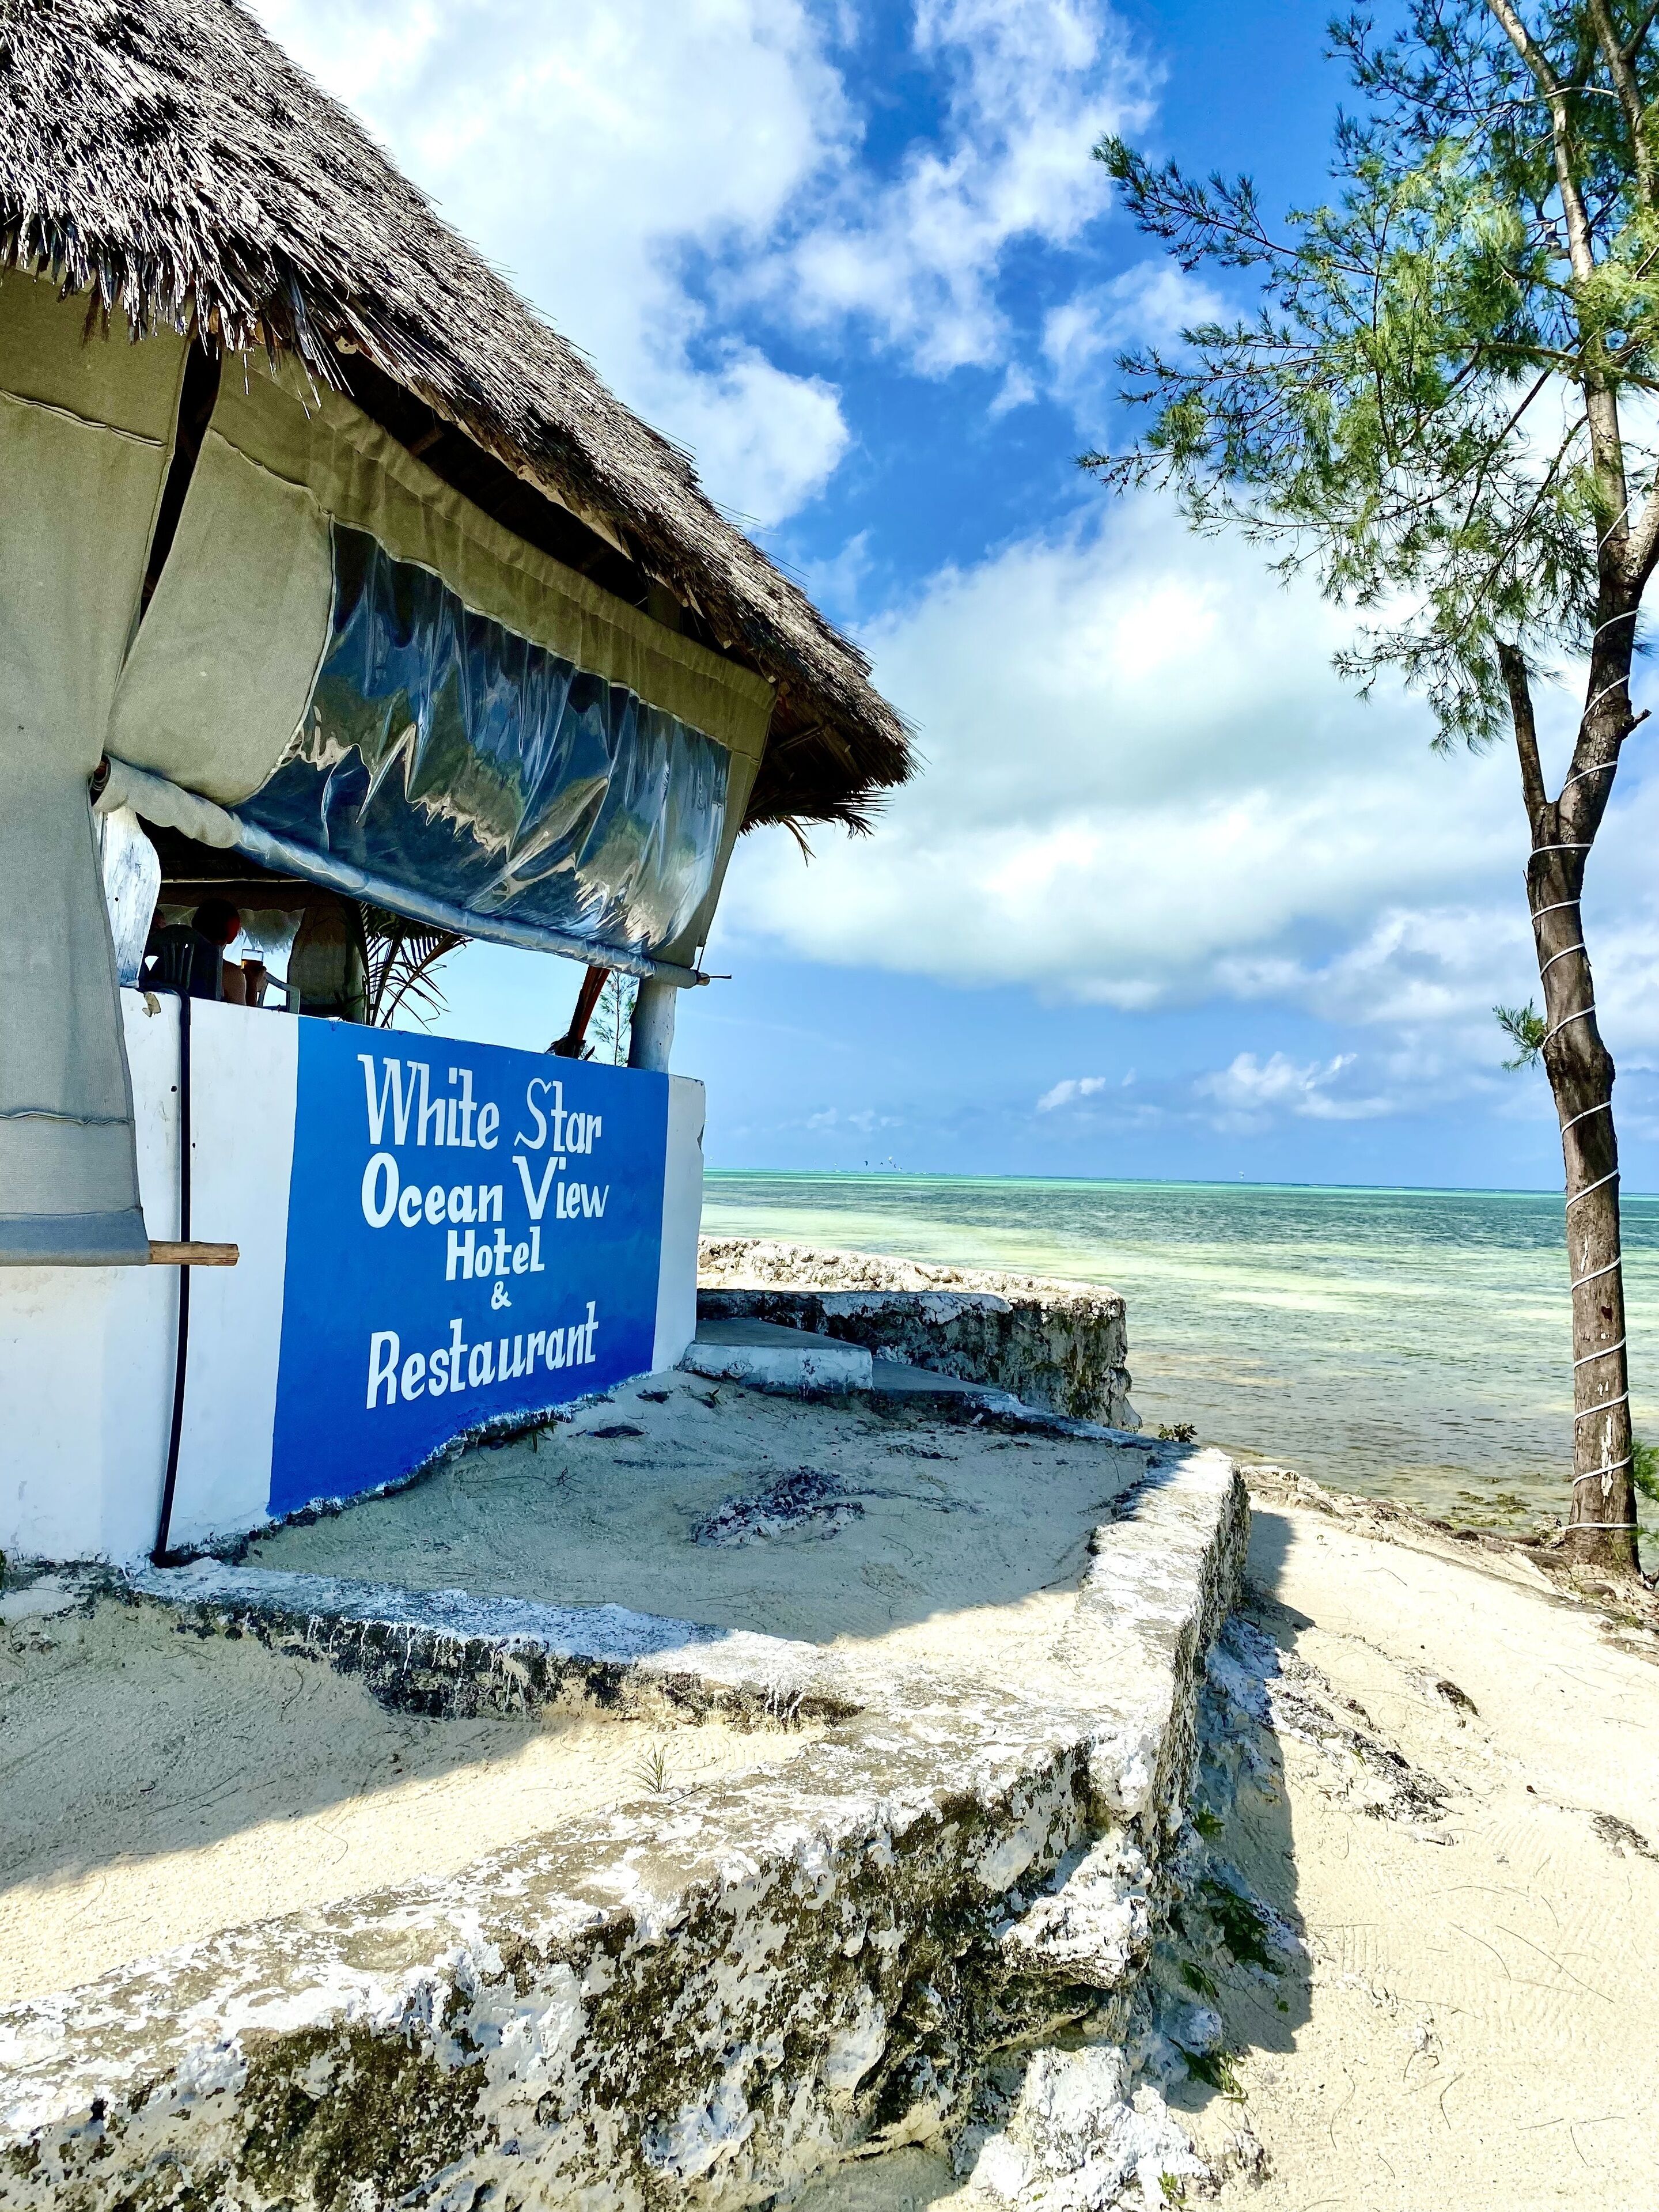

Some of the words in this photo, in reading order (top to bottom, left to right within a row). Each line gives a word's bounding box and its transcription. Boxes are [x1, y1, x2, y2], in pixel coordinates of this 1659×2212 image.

[357, 1054, 499, 1150] White
[514, 1078, 602, 1154] Star
[361, 1152, 503, 1228] Ocean
[512, 1156, 609, 1220] View
[445, 1226, 545, 1281] Hotel
[490, 1281, 512, 1310] &
[366, 1301, 599, 1410] Restaurant
